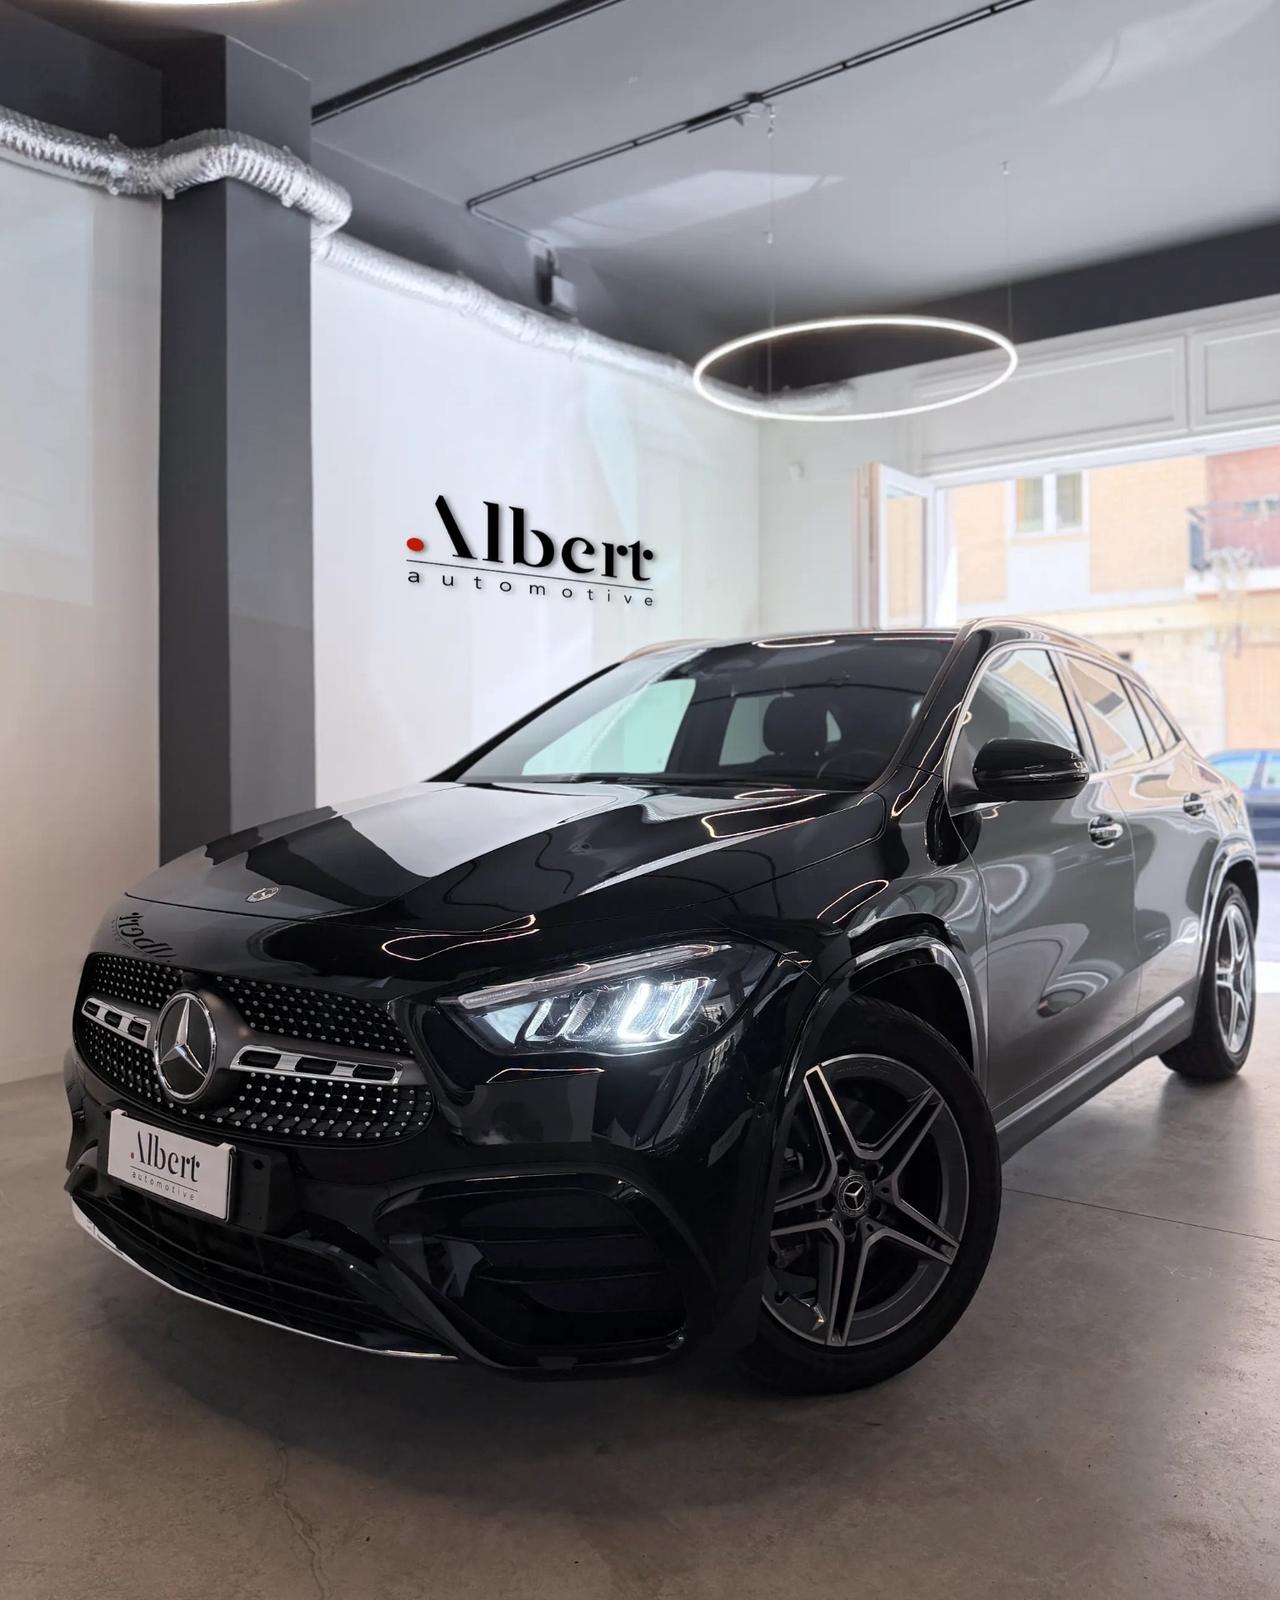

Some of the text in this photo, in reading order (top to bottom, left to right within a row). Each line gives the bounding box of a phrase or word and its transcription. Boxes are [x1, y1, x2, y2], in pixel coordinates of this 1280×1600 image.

[406, 494, 654, 581] Albert
[407, 570, 653, 606] automotive
[130, 1130, 200, 1182] Albert
[132, 1171, 195, 1200] automotive
